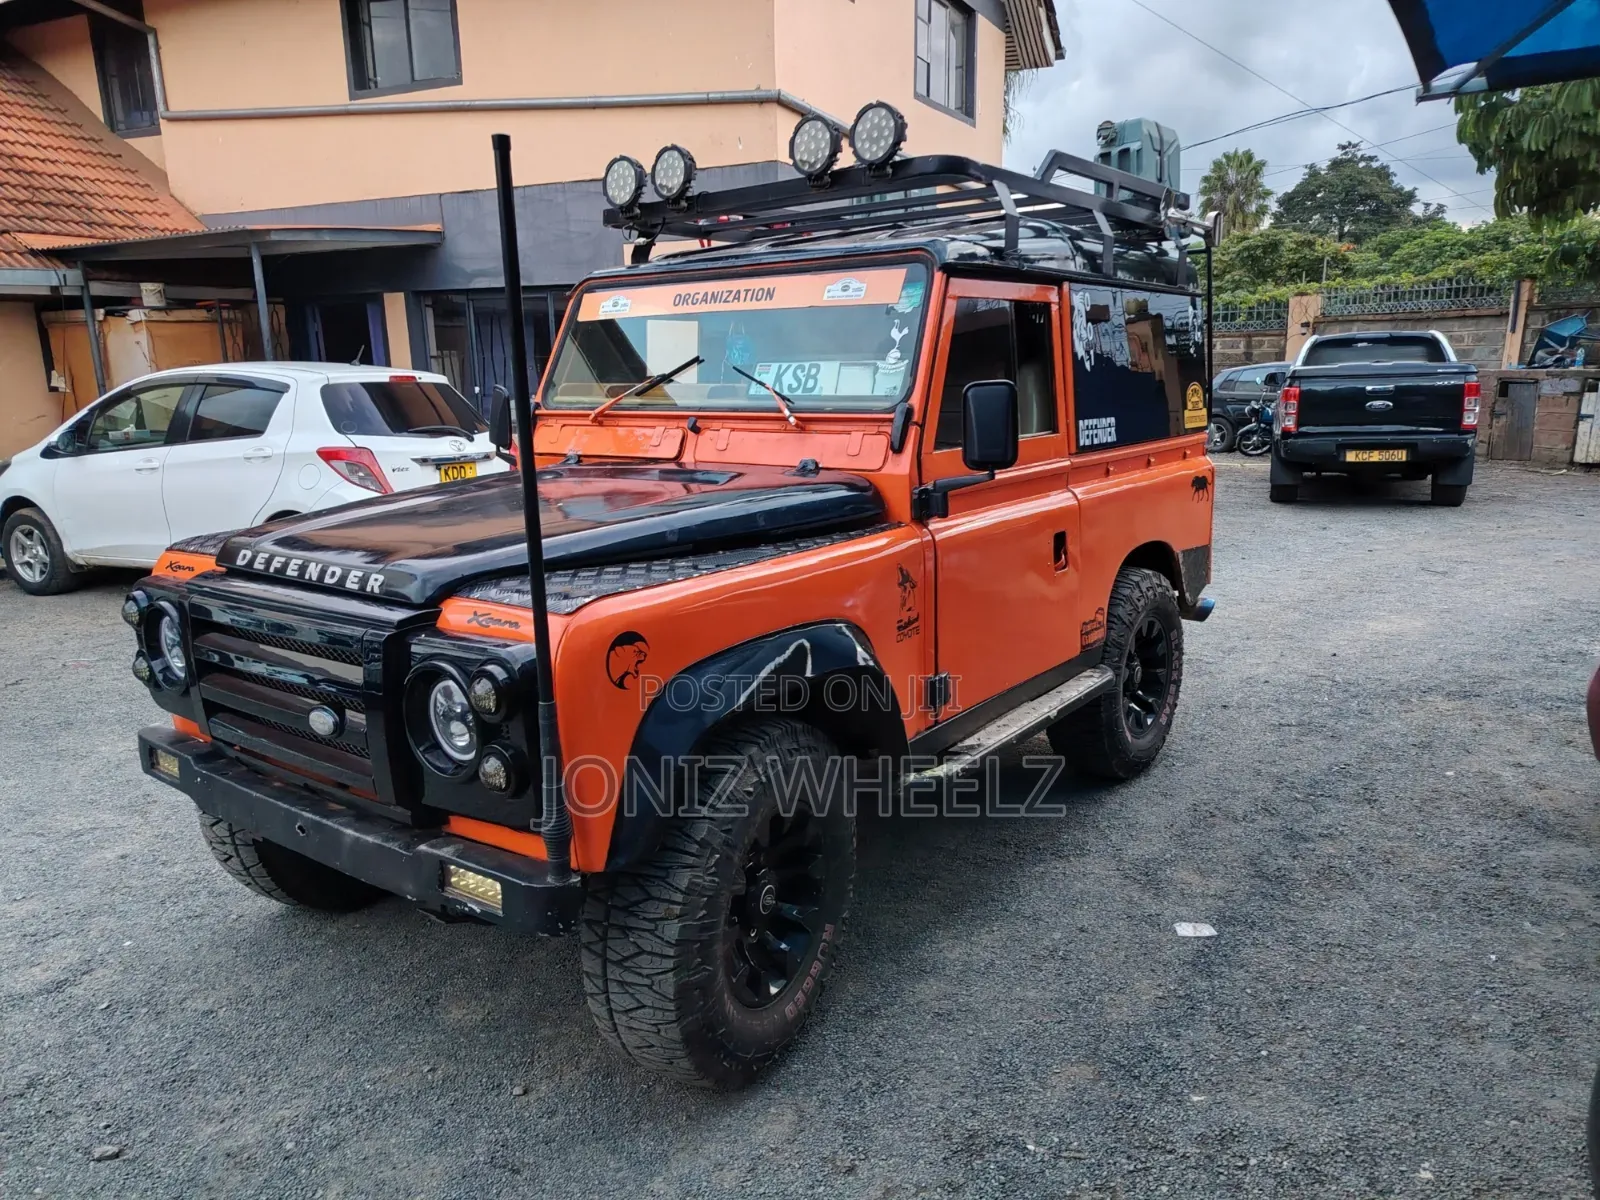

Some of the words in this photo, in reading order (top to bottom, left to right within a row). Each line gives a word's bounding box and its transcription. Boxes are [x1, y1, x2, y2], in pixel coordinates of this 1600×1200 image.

[673, 286, 776, 307] ORGANIZATION
[772, 363, 821, 394] KSB
[1079, 417, 1117, 446] DEFENDER
[1355, 450, 1375, 461] KCF
[1378, 450, 1403, 461] 506U
[444, 465, 467, 482] KDD
[236, 549, 385, 594] DEFENDER
[784, 923, 836, 1021] RUGGED
